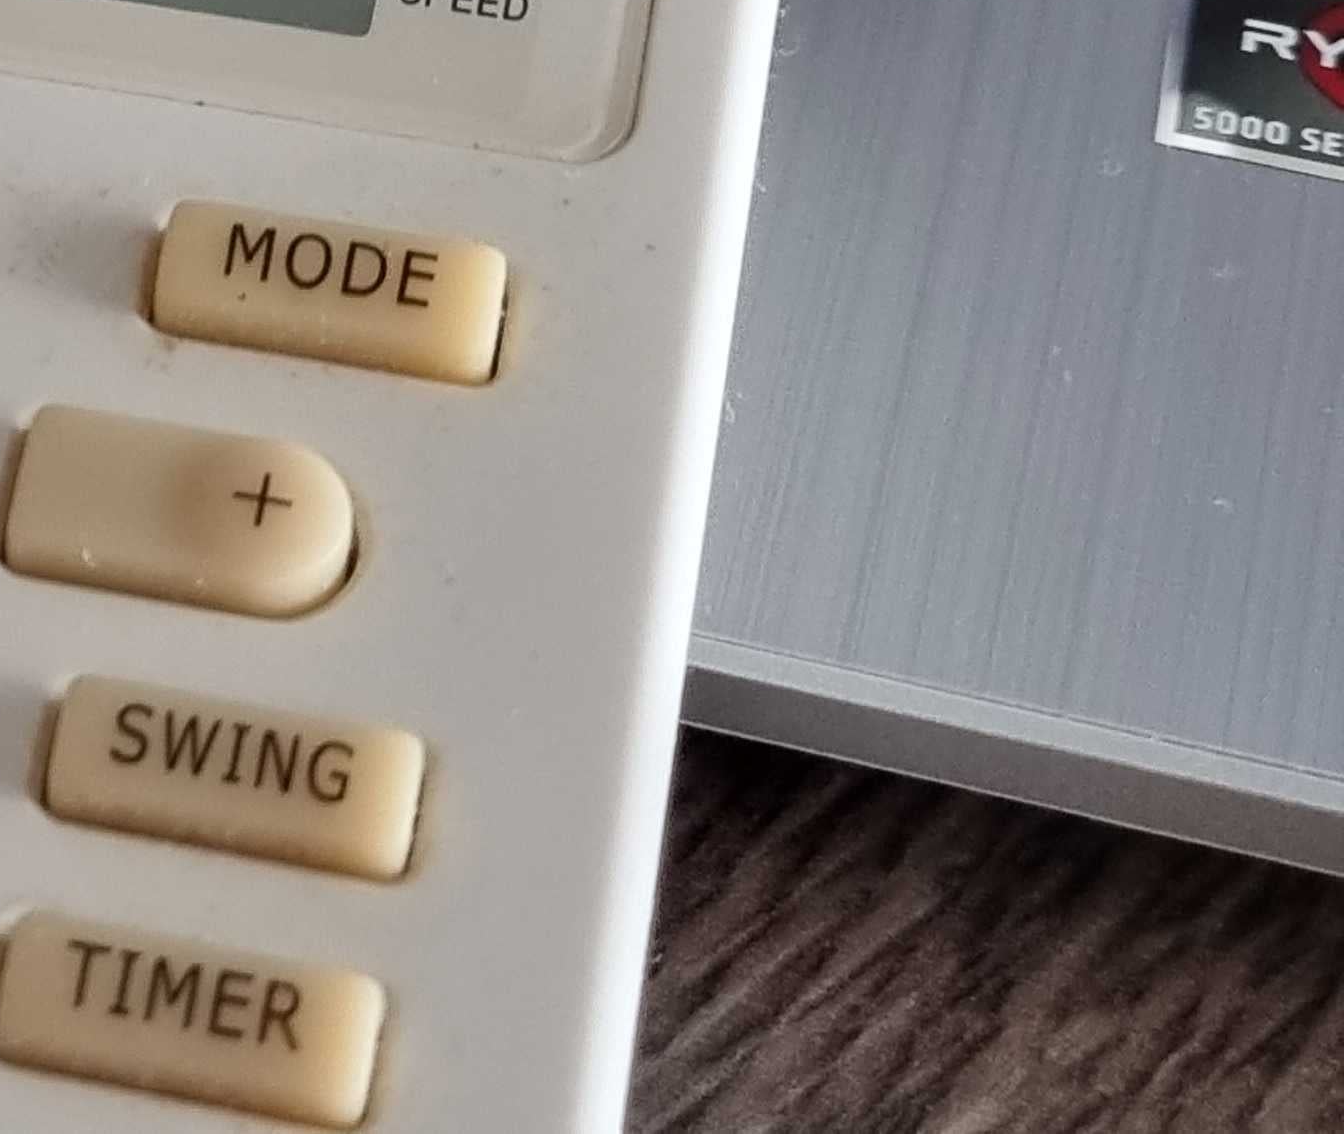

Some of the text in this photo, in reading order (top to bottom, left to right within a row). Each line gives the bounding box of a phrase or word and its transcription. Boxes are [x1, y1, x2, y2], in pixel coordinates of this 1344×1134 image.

[1193, 106, 1291, 145] 5000
[224, 224, 438, 308] MODE
[109, 703, 355, 804] SWING
[68, 939, 303, 1051] TIMER
